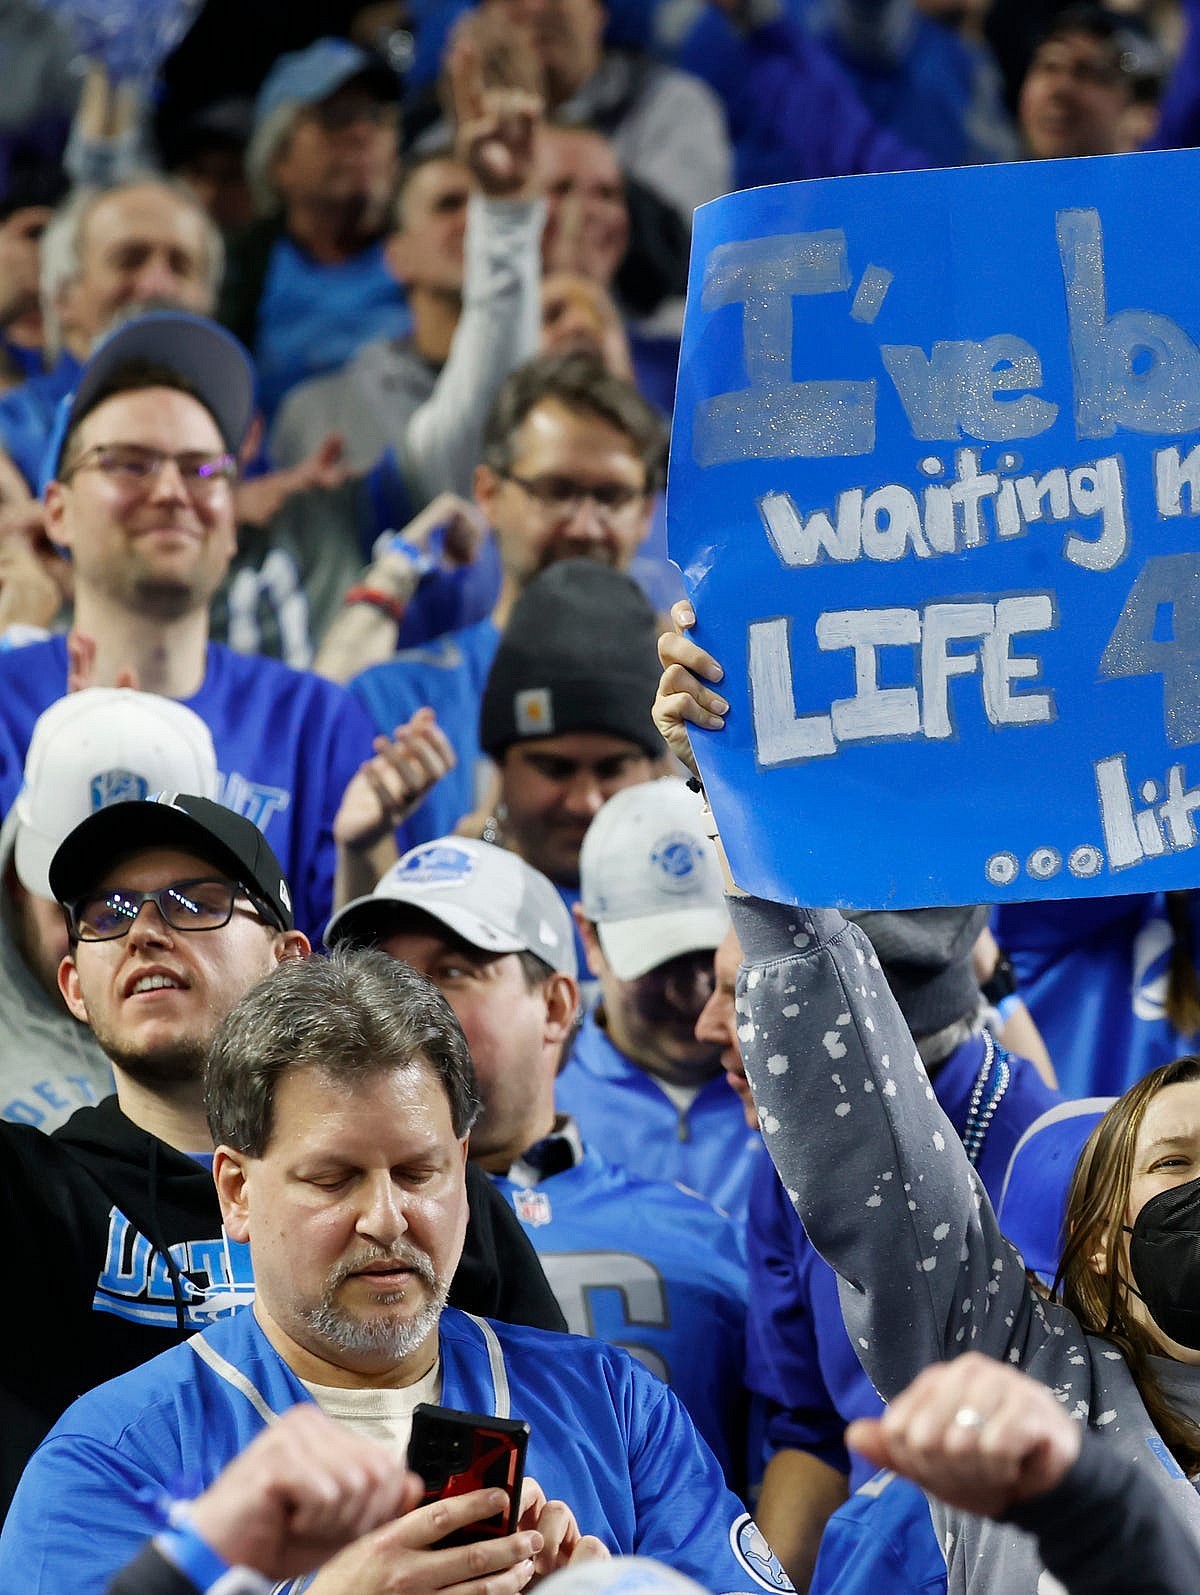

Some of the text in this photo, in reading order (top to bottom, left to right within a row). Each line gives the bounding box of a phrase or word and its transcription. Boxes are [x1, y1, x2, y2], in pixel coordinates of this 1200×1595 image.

[692, 227, 1060, 467] I've
[757, 445, 1128, 572] waiting
[746, 592, 1057, 768] LIFE
